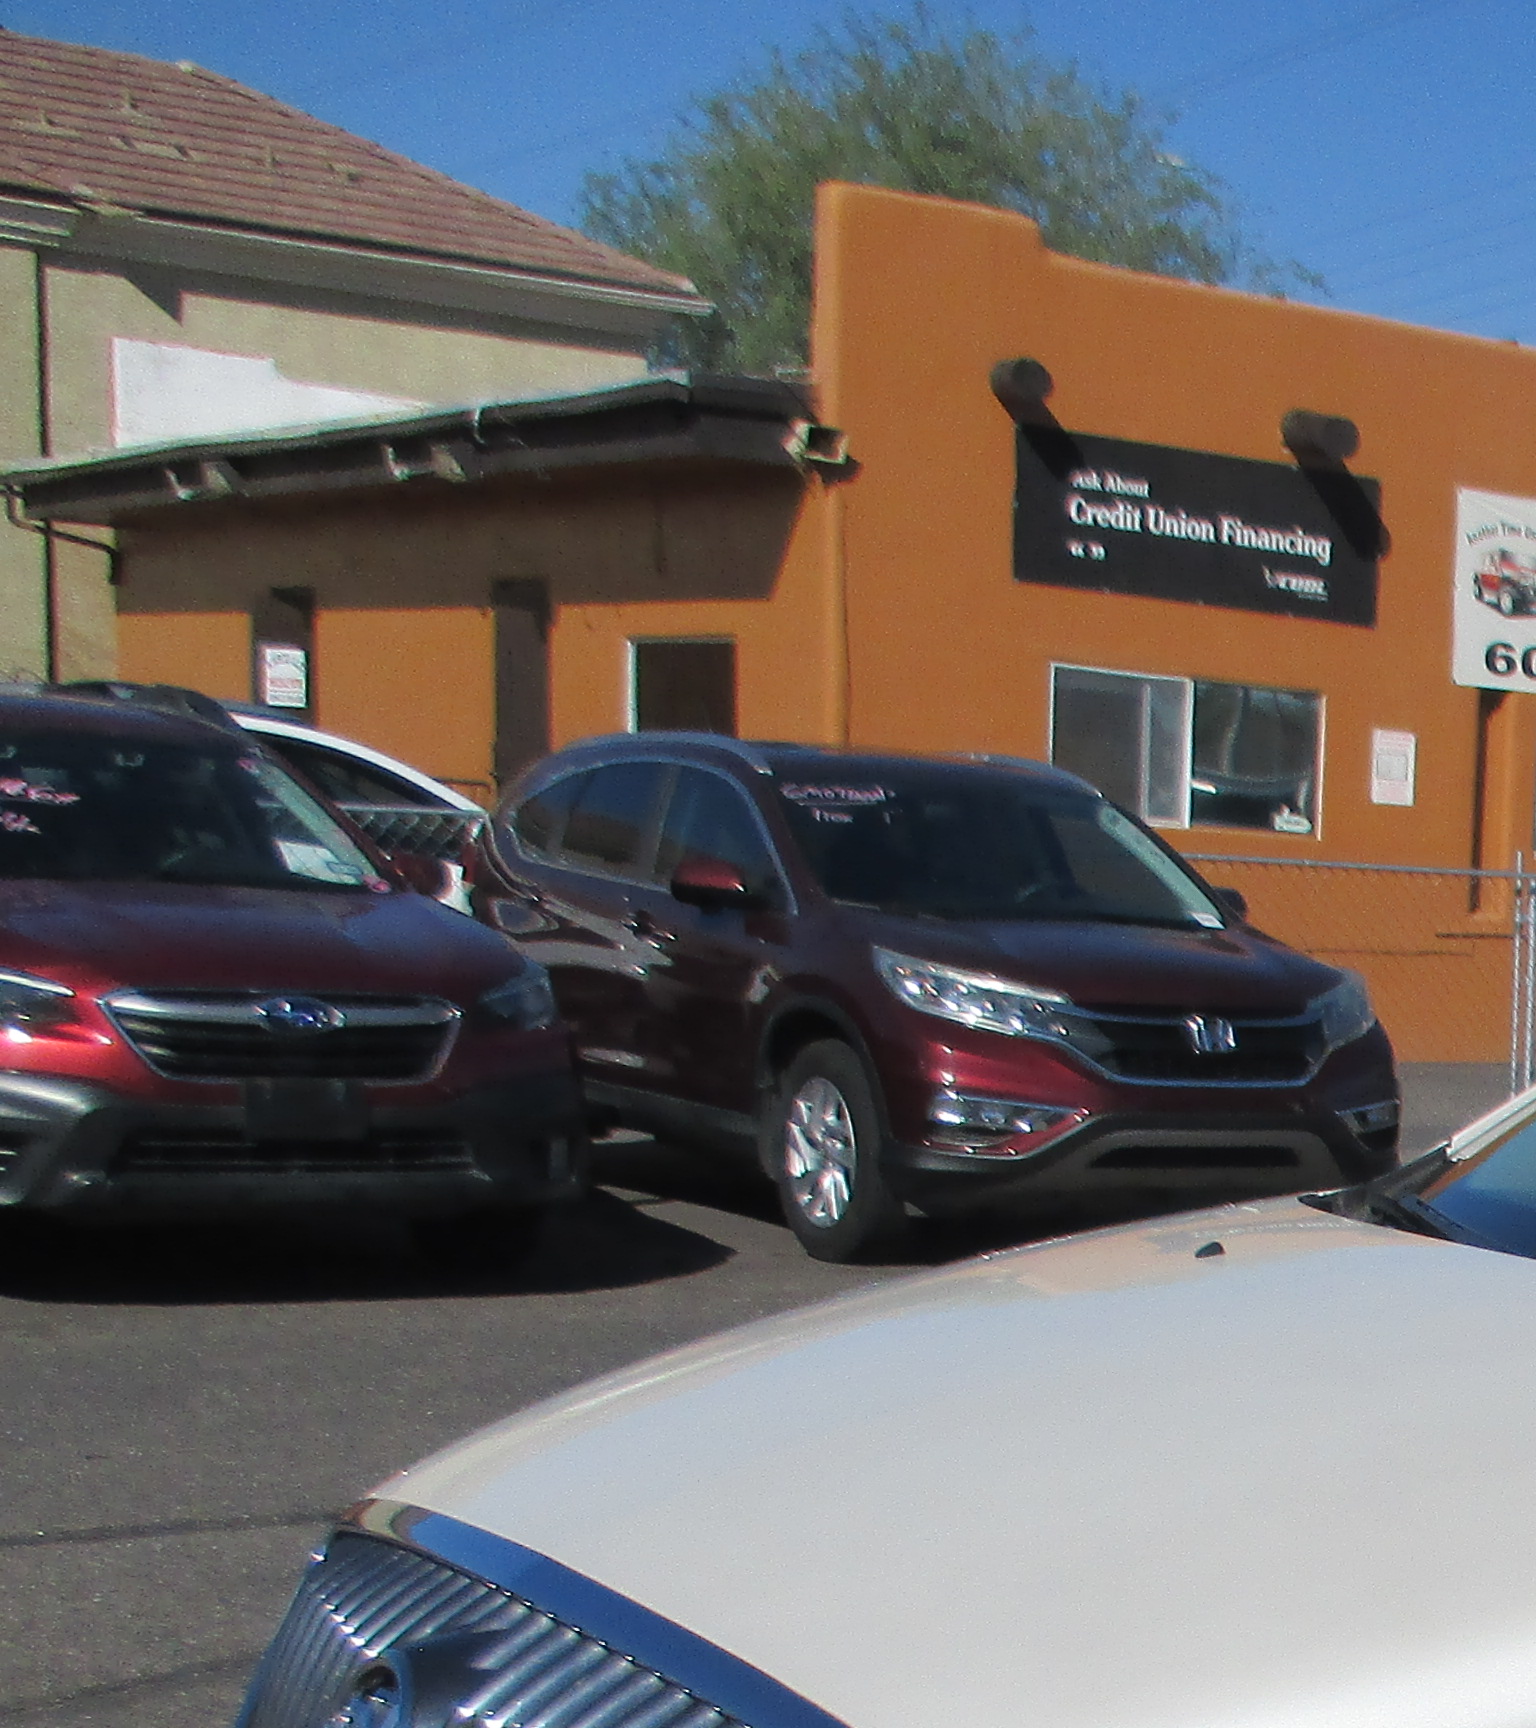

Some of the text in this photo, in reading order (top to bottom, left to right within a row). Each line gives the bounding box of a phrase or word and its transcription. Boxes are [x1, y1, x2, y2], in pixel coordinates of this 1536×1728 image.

[1071, 469, 1151, 498] Ask About
[1068, 496, 1333, 566] Credit Union Financing
